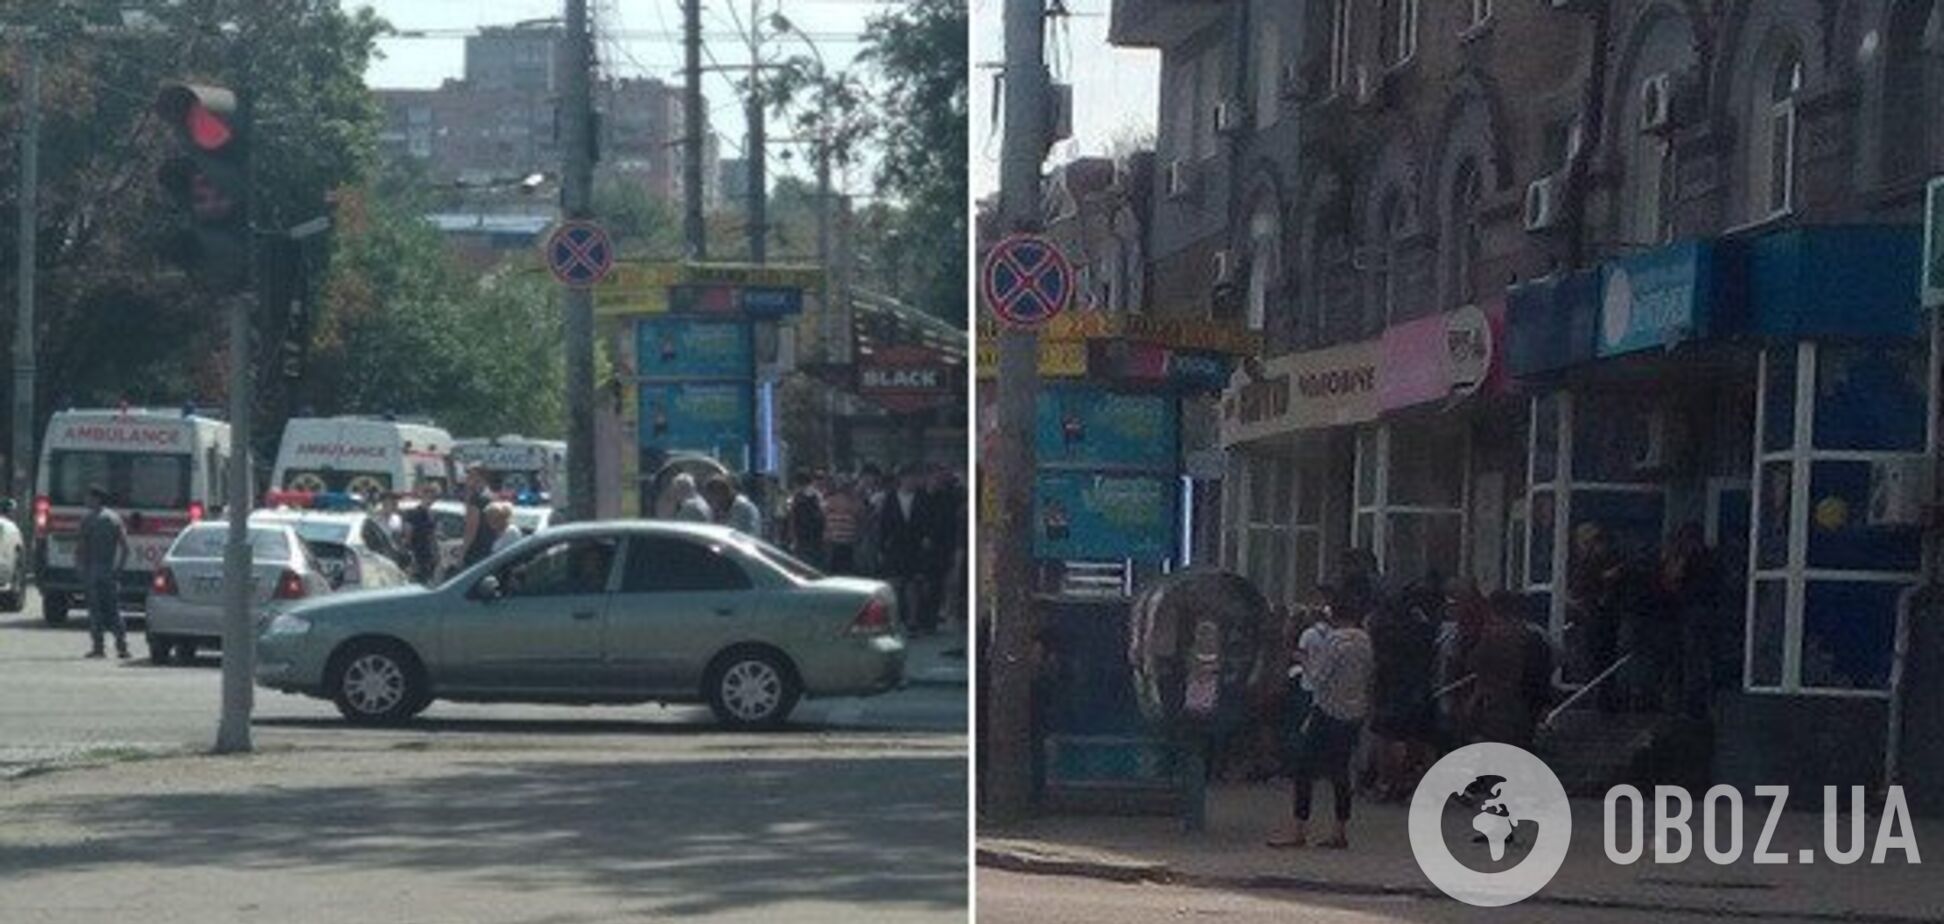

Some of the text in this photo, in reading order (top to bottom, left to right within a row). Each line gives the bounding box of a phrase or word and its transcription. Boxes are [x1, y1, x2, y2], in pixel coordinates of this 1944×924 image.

[863, 369, 937, 387] BLACK
[64, 424, 180, 445] AMBULANCE
[296, 442, 386, 458] AMBULANCE
